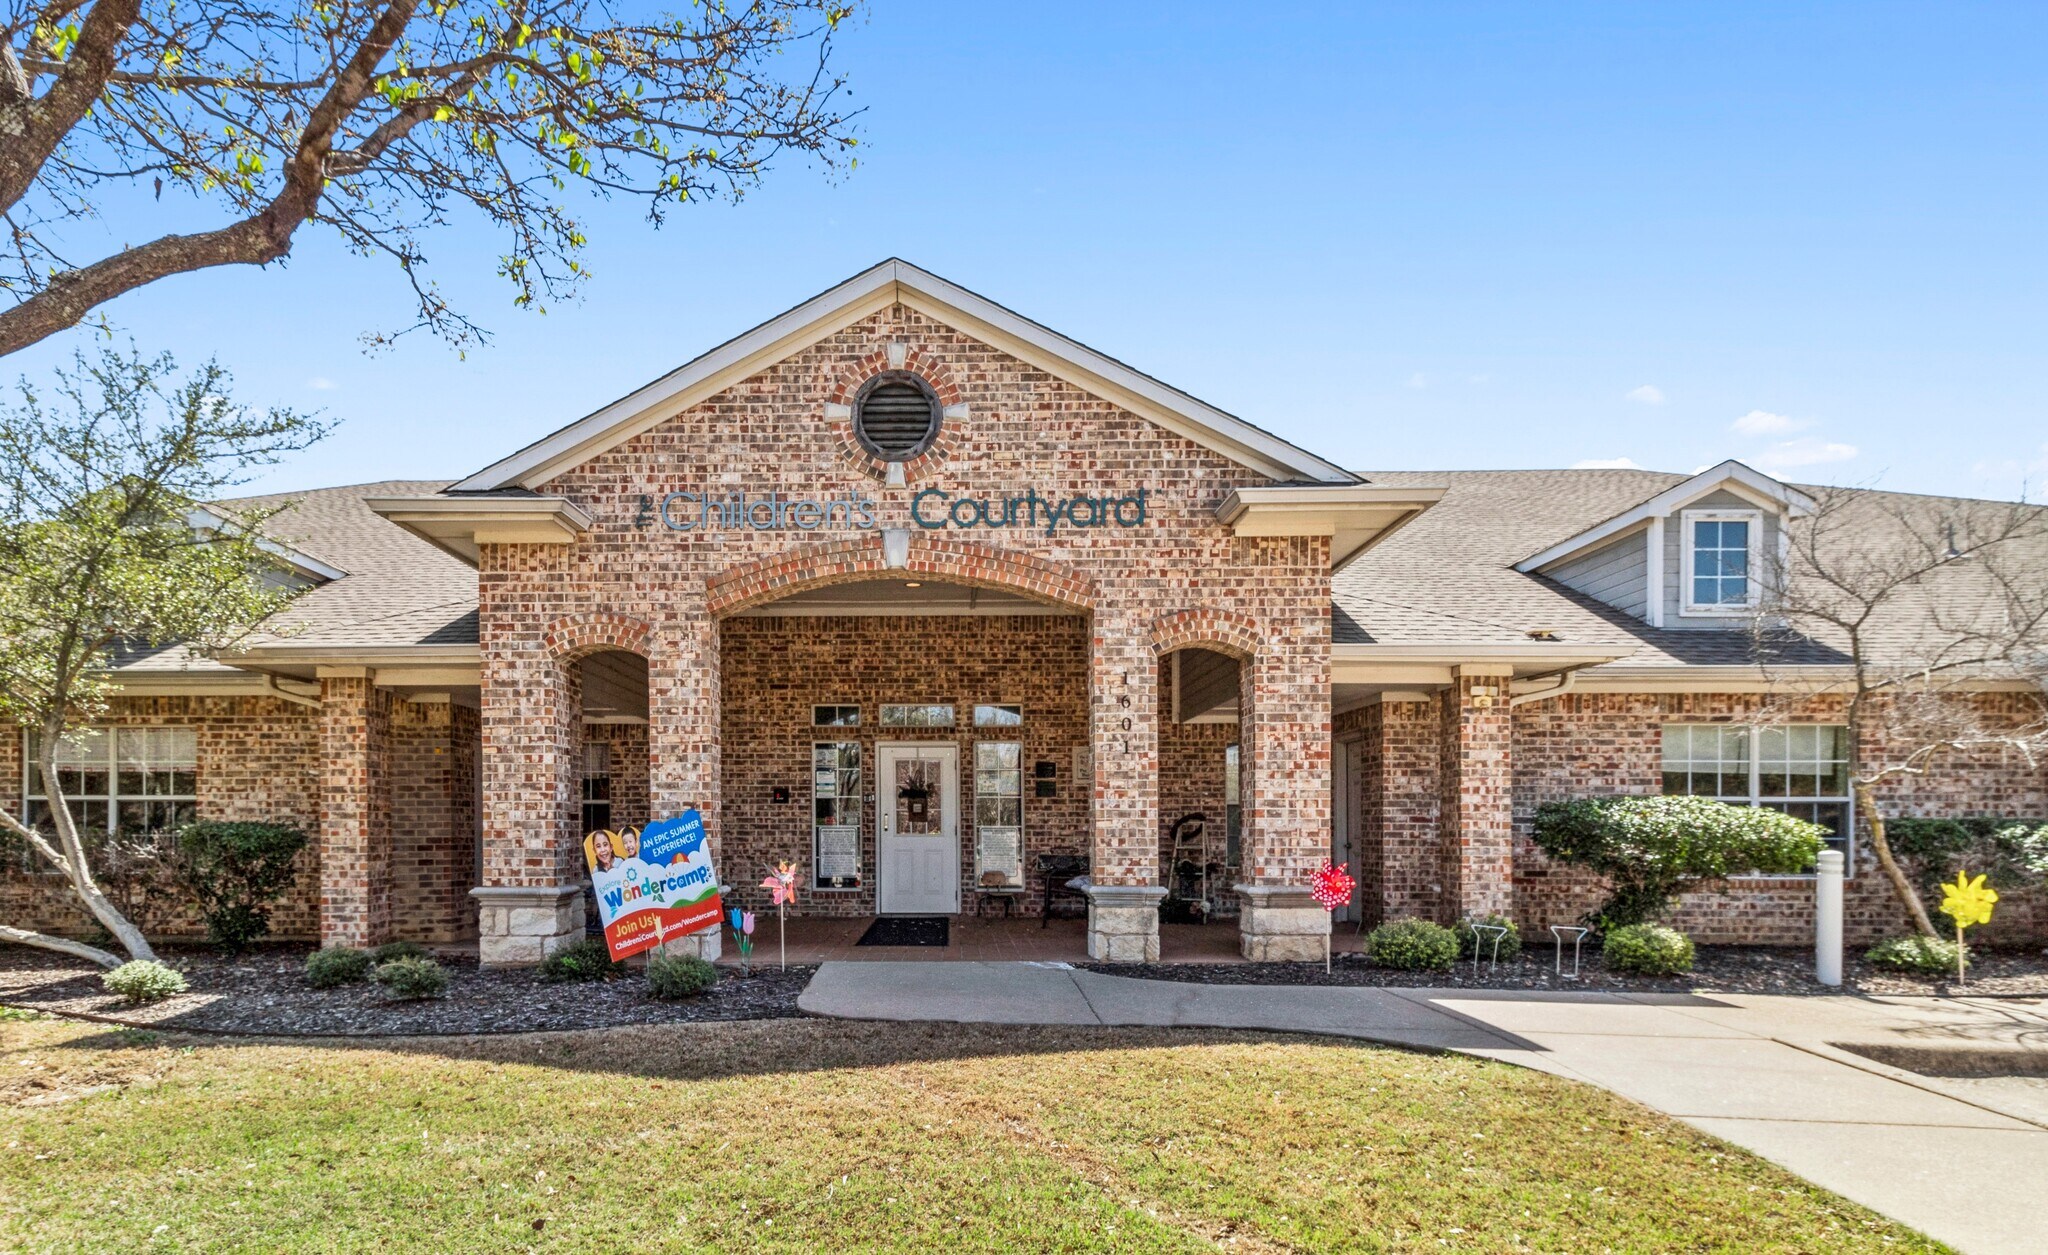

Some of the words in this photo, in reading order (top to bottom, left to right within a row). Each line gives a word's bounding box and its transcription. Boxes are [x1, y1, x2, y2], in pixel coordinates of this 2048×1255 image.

[661, 489, 875, 531] Children's
[911, 487, 1146, 536] Courtyard
[1121, 671, 1132, 754] 1601
[643, 838, 654, 850] AN
[653, 832, 670, 845] EPIC
[669, 819, 700, 838] SUMMER
[652, 832, 697, 857] EXPERIENCE!
[604, 865, 707, 908] Wondercamp
[616, 921, 638, 938] Join
[638, 912, 656, 929] Us!
